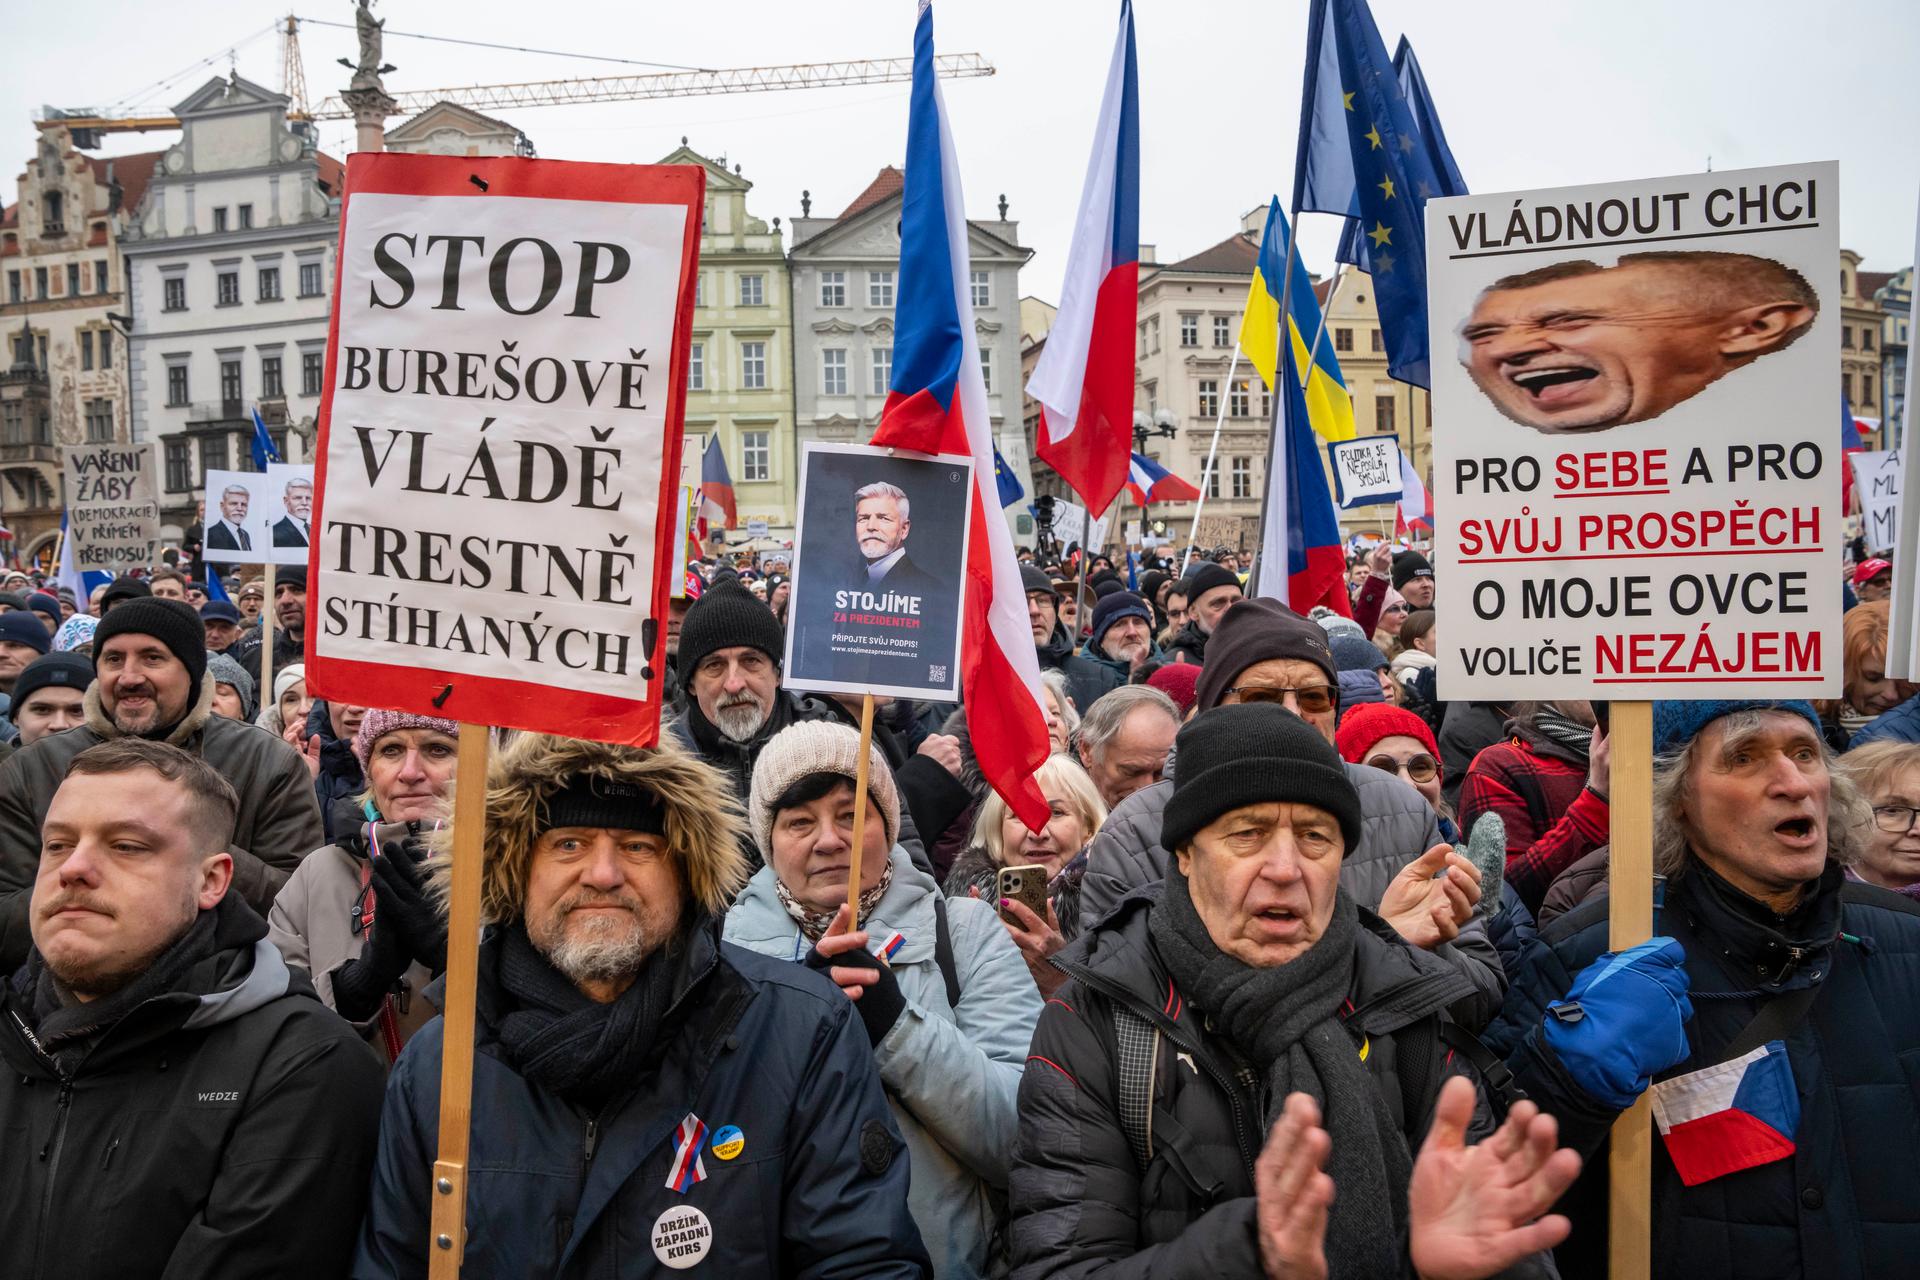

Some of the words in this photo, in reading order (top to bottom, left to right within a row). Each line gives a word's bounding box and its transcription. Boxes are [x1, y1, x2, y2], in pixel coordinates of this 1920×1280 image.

[1448, 192, 1690, 251] VLÁDNOUT
[1704, 179, 1817, 228] CHCI
[369, 232, 631, 319] STOP
[340, 339, 649, 410] BUREŠOVĚ
[71, 448, 148, 474] VAŘENÍ
[1375, 444, 1386, 456] SE
[353, 417, 623, 512] VLÁDĚ
[1455, 455, 1541, 495] PRO
[1554, 449, 1668, 490] SEBE
[1681, 447, 1713, 485] A
[1727, 441, 1823, 482] PRO
[76, 475, 137, 501] ŽÁBY
[73, 527, 85, 542] V
[1458, 505, 1562, 556] SVŮJ
[1579, 499, 1821, 552] PROSPĚCH
[327, 521, 635, 606] TRESTNĚ
[835, 590, 921, 615] STOJÍME
[1472, 580, 1505, 620] O
[1522, 575, 1652, 619] MOJE
[1669, 571, 1809, 616] OVCE
[833, 612, 847, 623] ZA
[849, 613, 920, 629] PREZIDENTEM
[831, 632, 868, 644] PŘIPOJTE
[868, 635, 888, 646] SVŮJ
[889, 638, 918, 649] PODPIS!
[831, 646, 918, 658] www.stojimezaprezidentem.cz
[1460, 639, 1581, 677] VOLIČE
[1595, 622, 1822, 675] NEZÁJEM
[198, 1091, 239, 1101] WEDZE
[655, 1223, 709, 1248] ZÁPADNÍ
[660, 1214, 700, 1233] DRŽÍM
[667, 1242, 701, 1259] KURS
